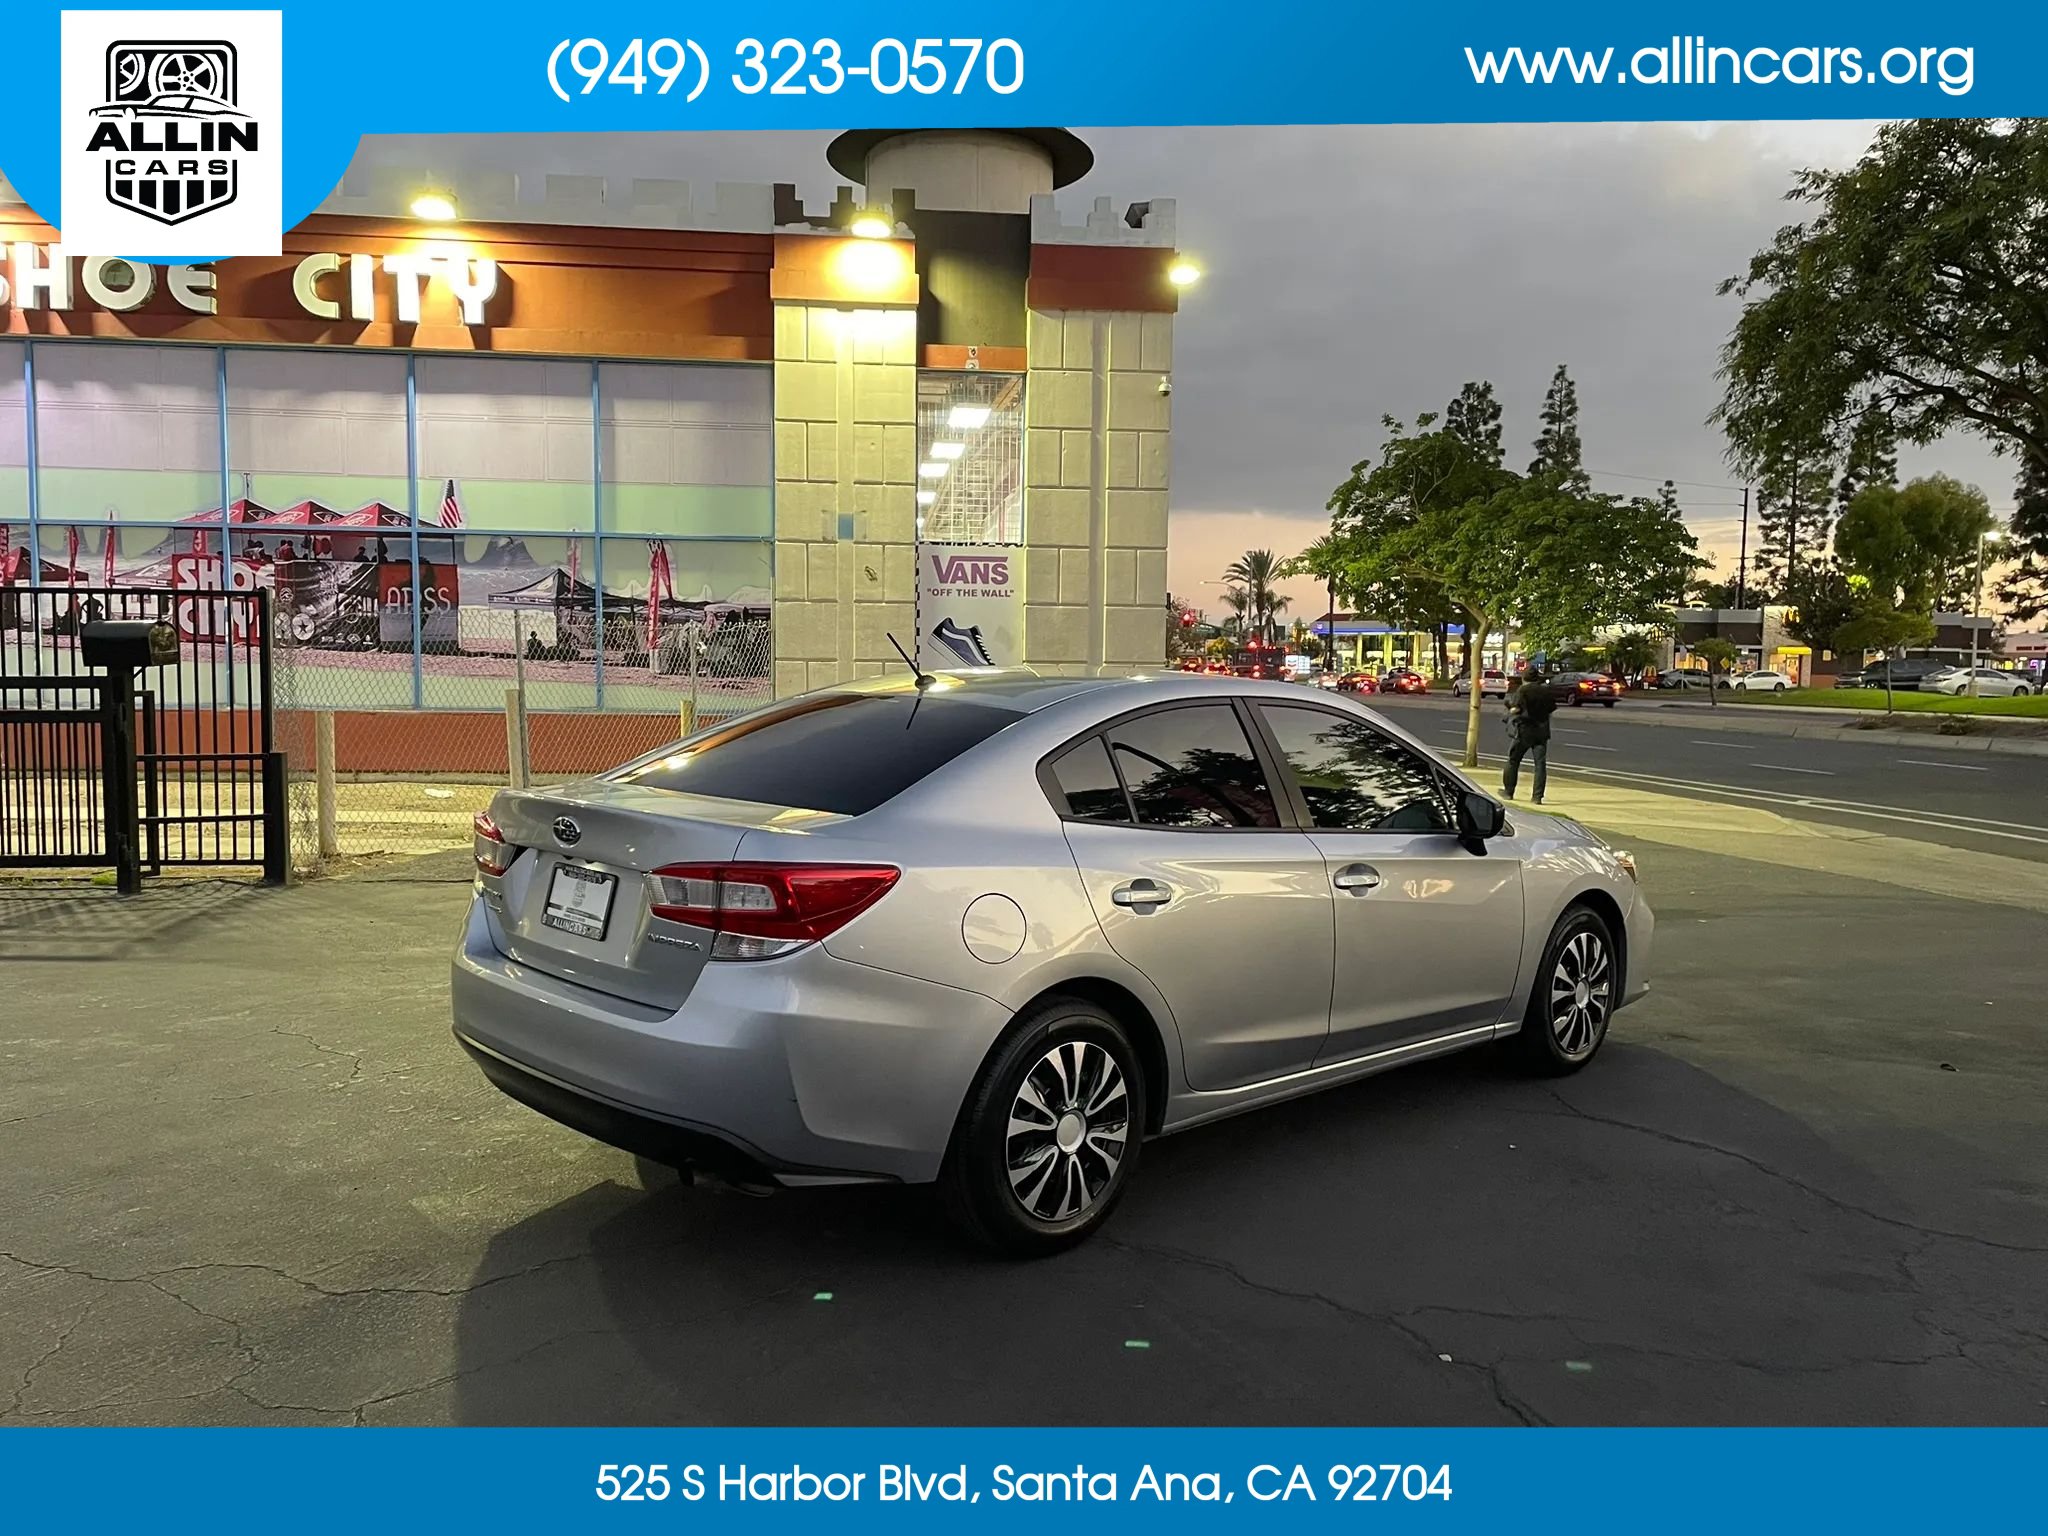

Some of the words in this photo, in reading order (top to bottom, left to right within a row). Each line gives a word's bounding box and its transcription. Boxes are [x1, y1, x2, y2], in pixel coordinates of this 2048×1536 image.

[0, 240, 218, 316] HOE
[292, 252, 498, 325] CITY
[931, 555, 1009, 585] VANS
[927, 588, 953, 598] "OFF
[956, 588, 978, 598] THE
[981, 588, 1015, 598] WALL"
[178, 597, 254, 639] CITY
